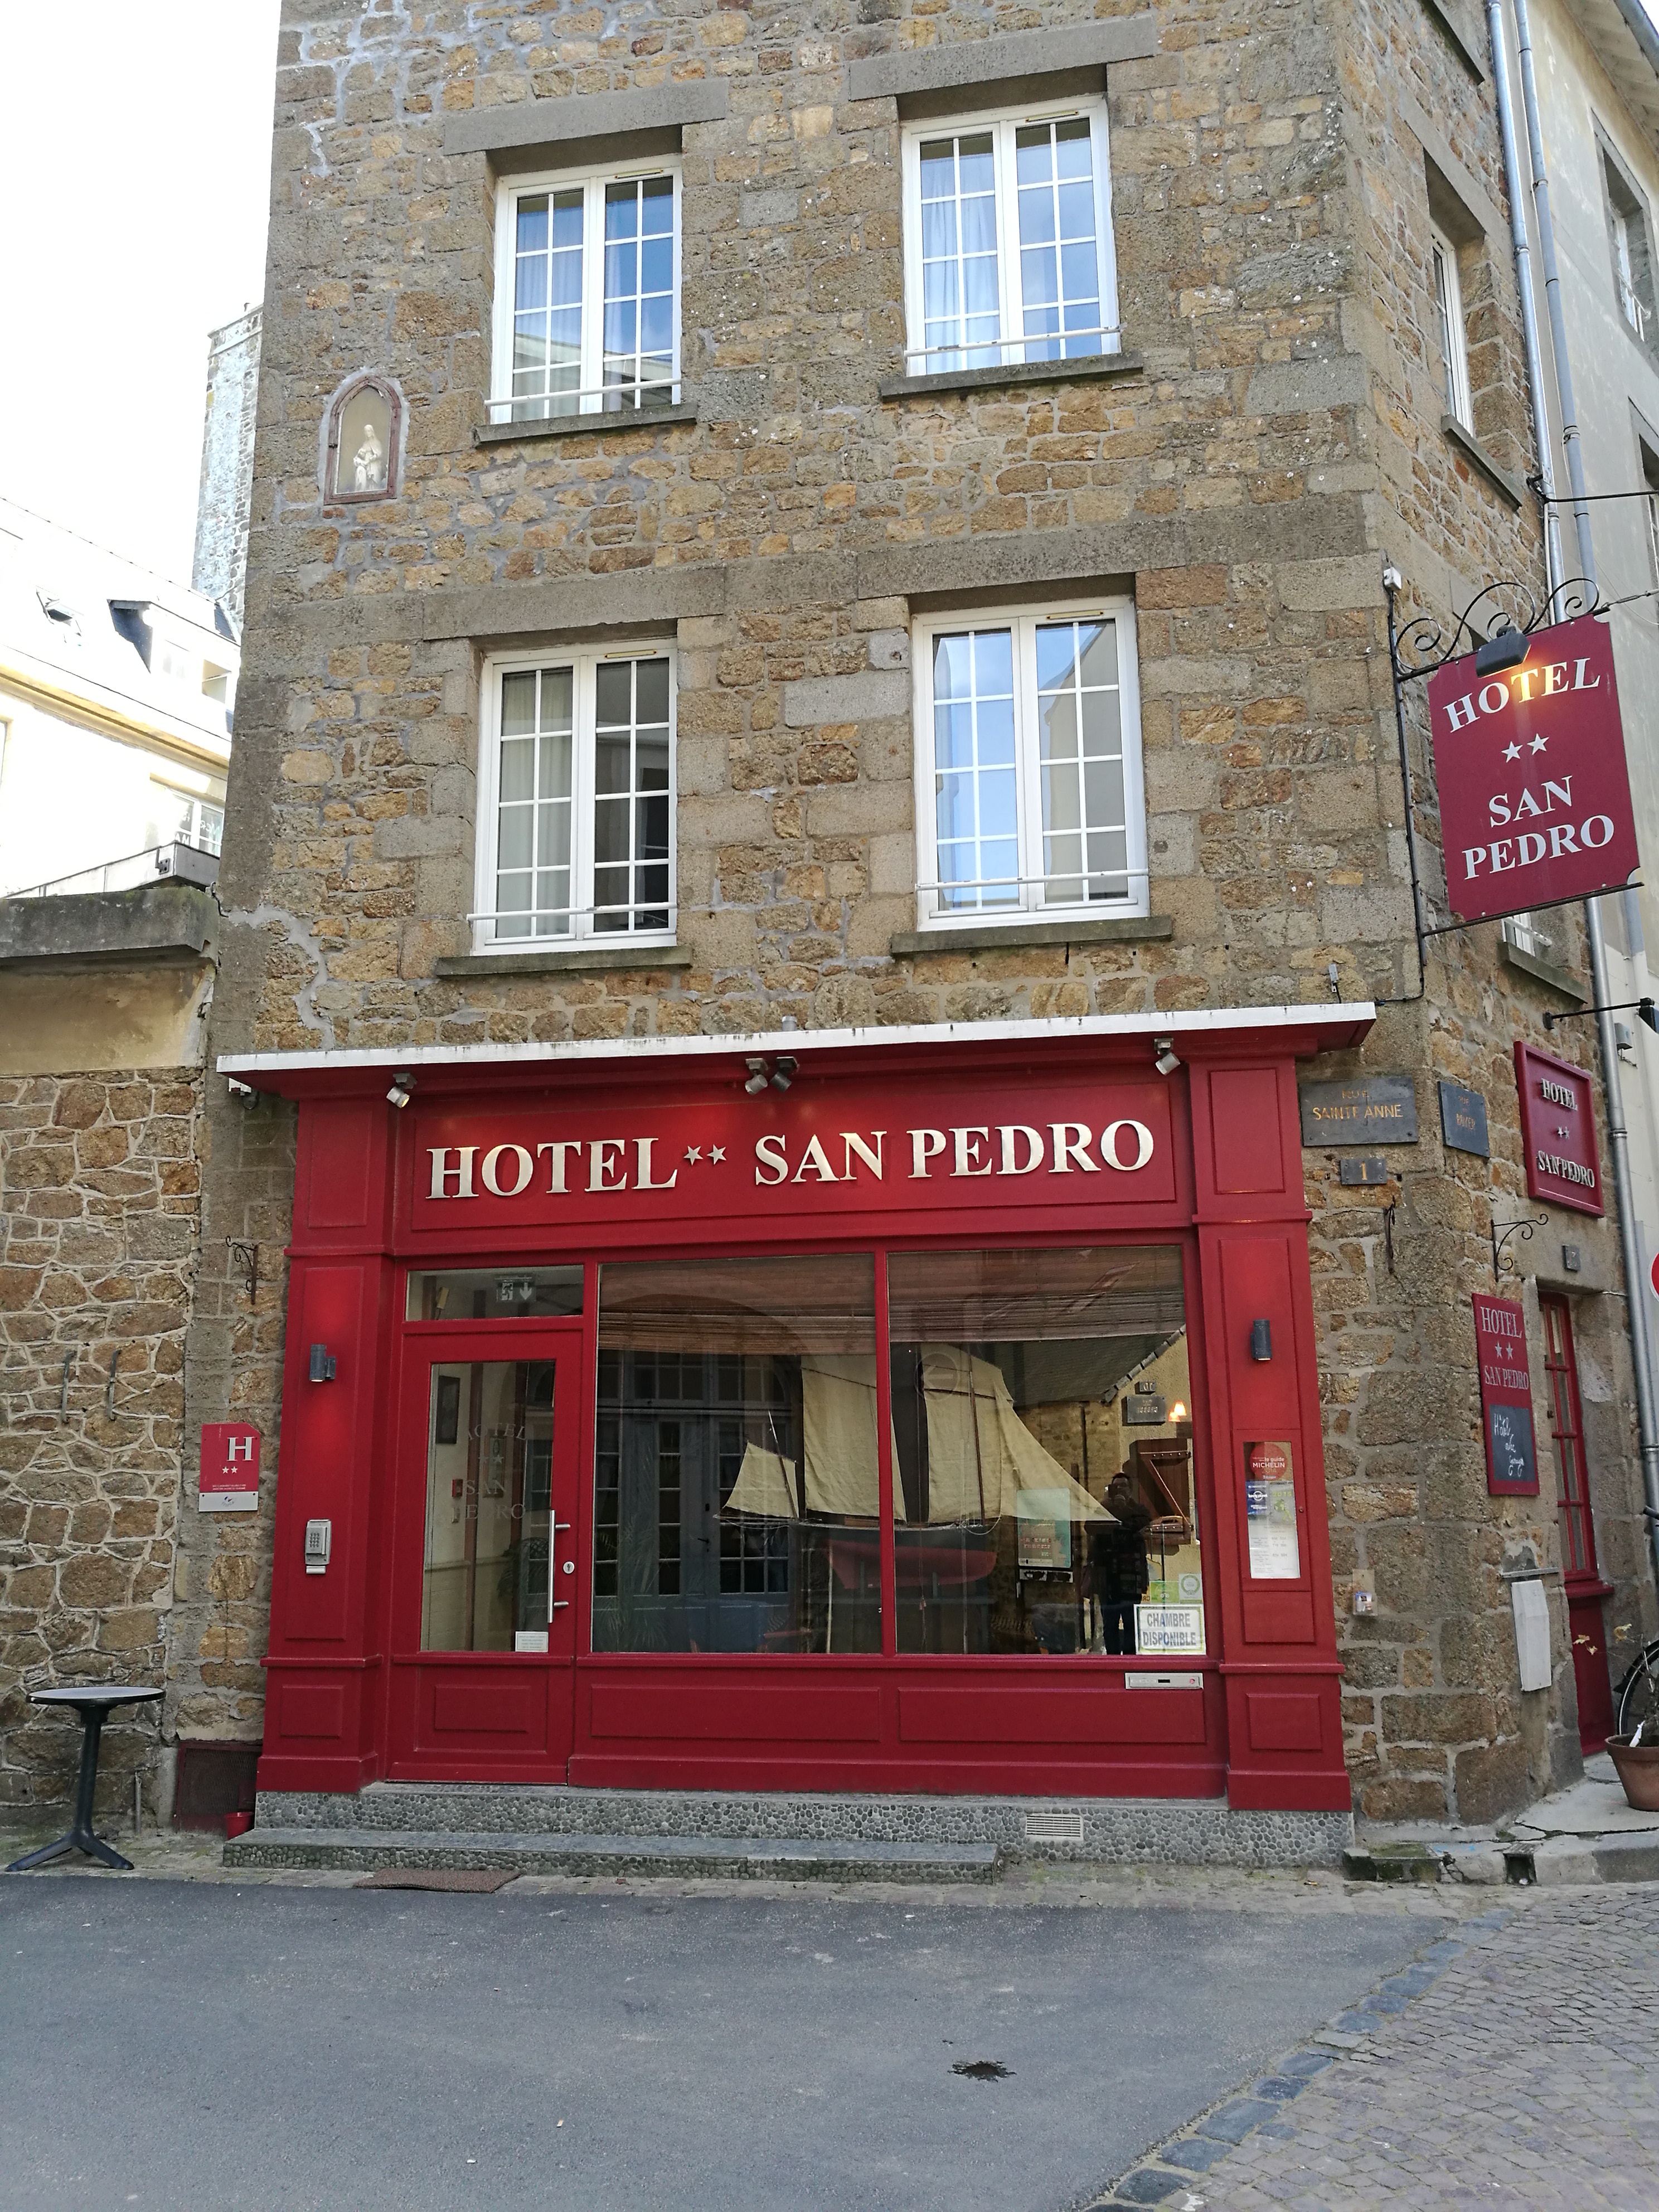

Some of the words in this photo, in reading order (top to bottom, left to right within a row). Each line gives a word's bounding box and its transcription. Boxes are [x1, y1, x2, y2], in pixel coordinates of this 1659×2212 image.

[1443, 658, 1600, 733] HOTEL
[1489, 775, 1573, 827] SAN
[1462, 814, 1614, 880] PEDRO
[1342, 1090, 1369, 1099] RUE
[1541, 1078, 1578, 1111] HOTEL
[1313, 1106, 1360, 1120] SAINTE
[1364, 1104, 1403, 1119] ANNE
[425, 1138, 678, 1200] HOTEL
[754, 1131, 887, 1186] SAN
[907, 1119, 1154, 1178] PEDRO
[1359, 1162, 1367, 1180] 1
[1537, 1150, 1560, 1176] SAN
[1560, 1158, 1595, 1189] PEDRO
[1480, 1306, 1522, 1338] HOTEL
[1484, 1365, 1501, 1386] SAN
[1502, 1369, 1529, 1390] PEDRO
[226, 1437, 255, 1462] H
[1147, 1613, 1191, 1627] CHAMBRE
[1143, 1632, 1196, 1646] DISPONIBLE
